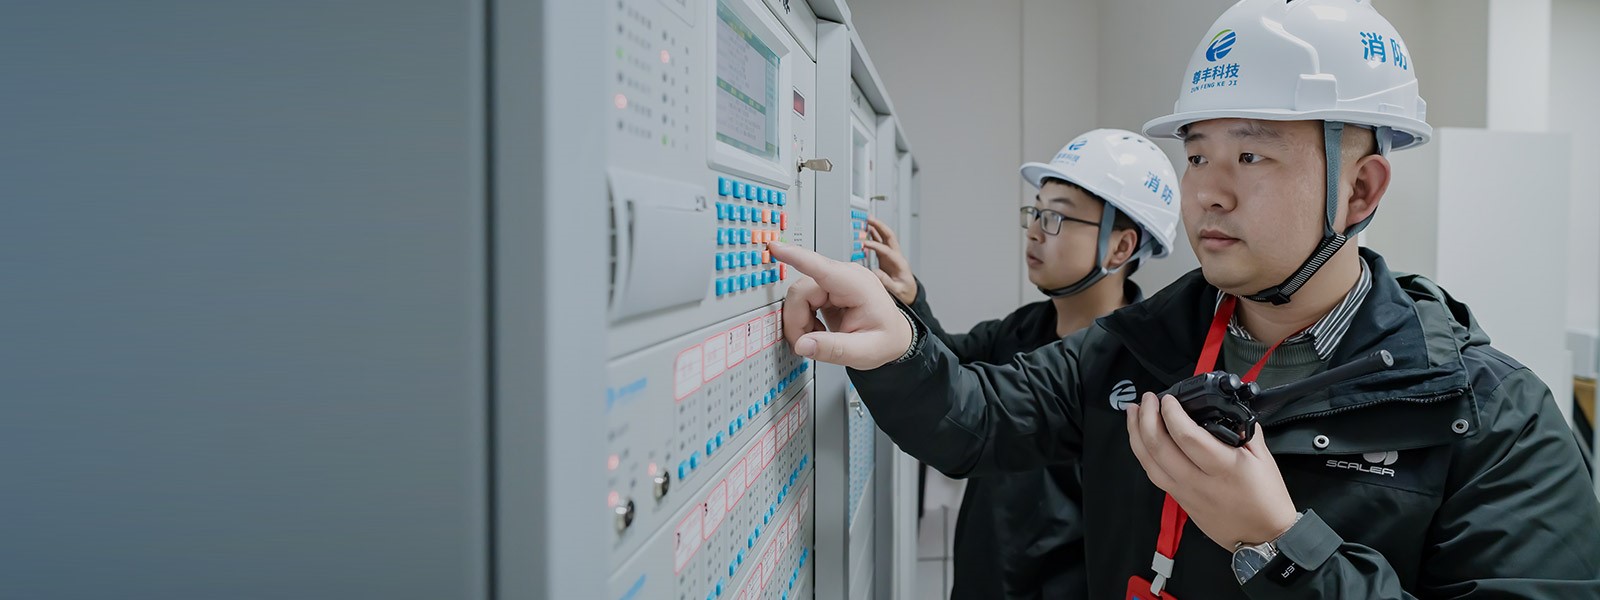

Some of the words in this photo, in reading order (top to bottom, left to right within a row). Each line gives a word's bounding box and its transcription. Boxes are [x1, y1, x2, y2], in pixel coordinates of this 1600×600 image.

[1360, 31, 1407, 70] 消防
[1192, 62, 1240, 85] 尊丰科技
[1144, 171, 1174, 205] 消防
[1325, 459, 1396, 478] SCALER
[1281, 562, 1296, 579] ER
